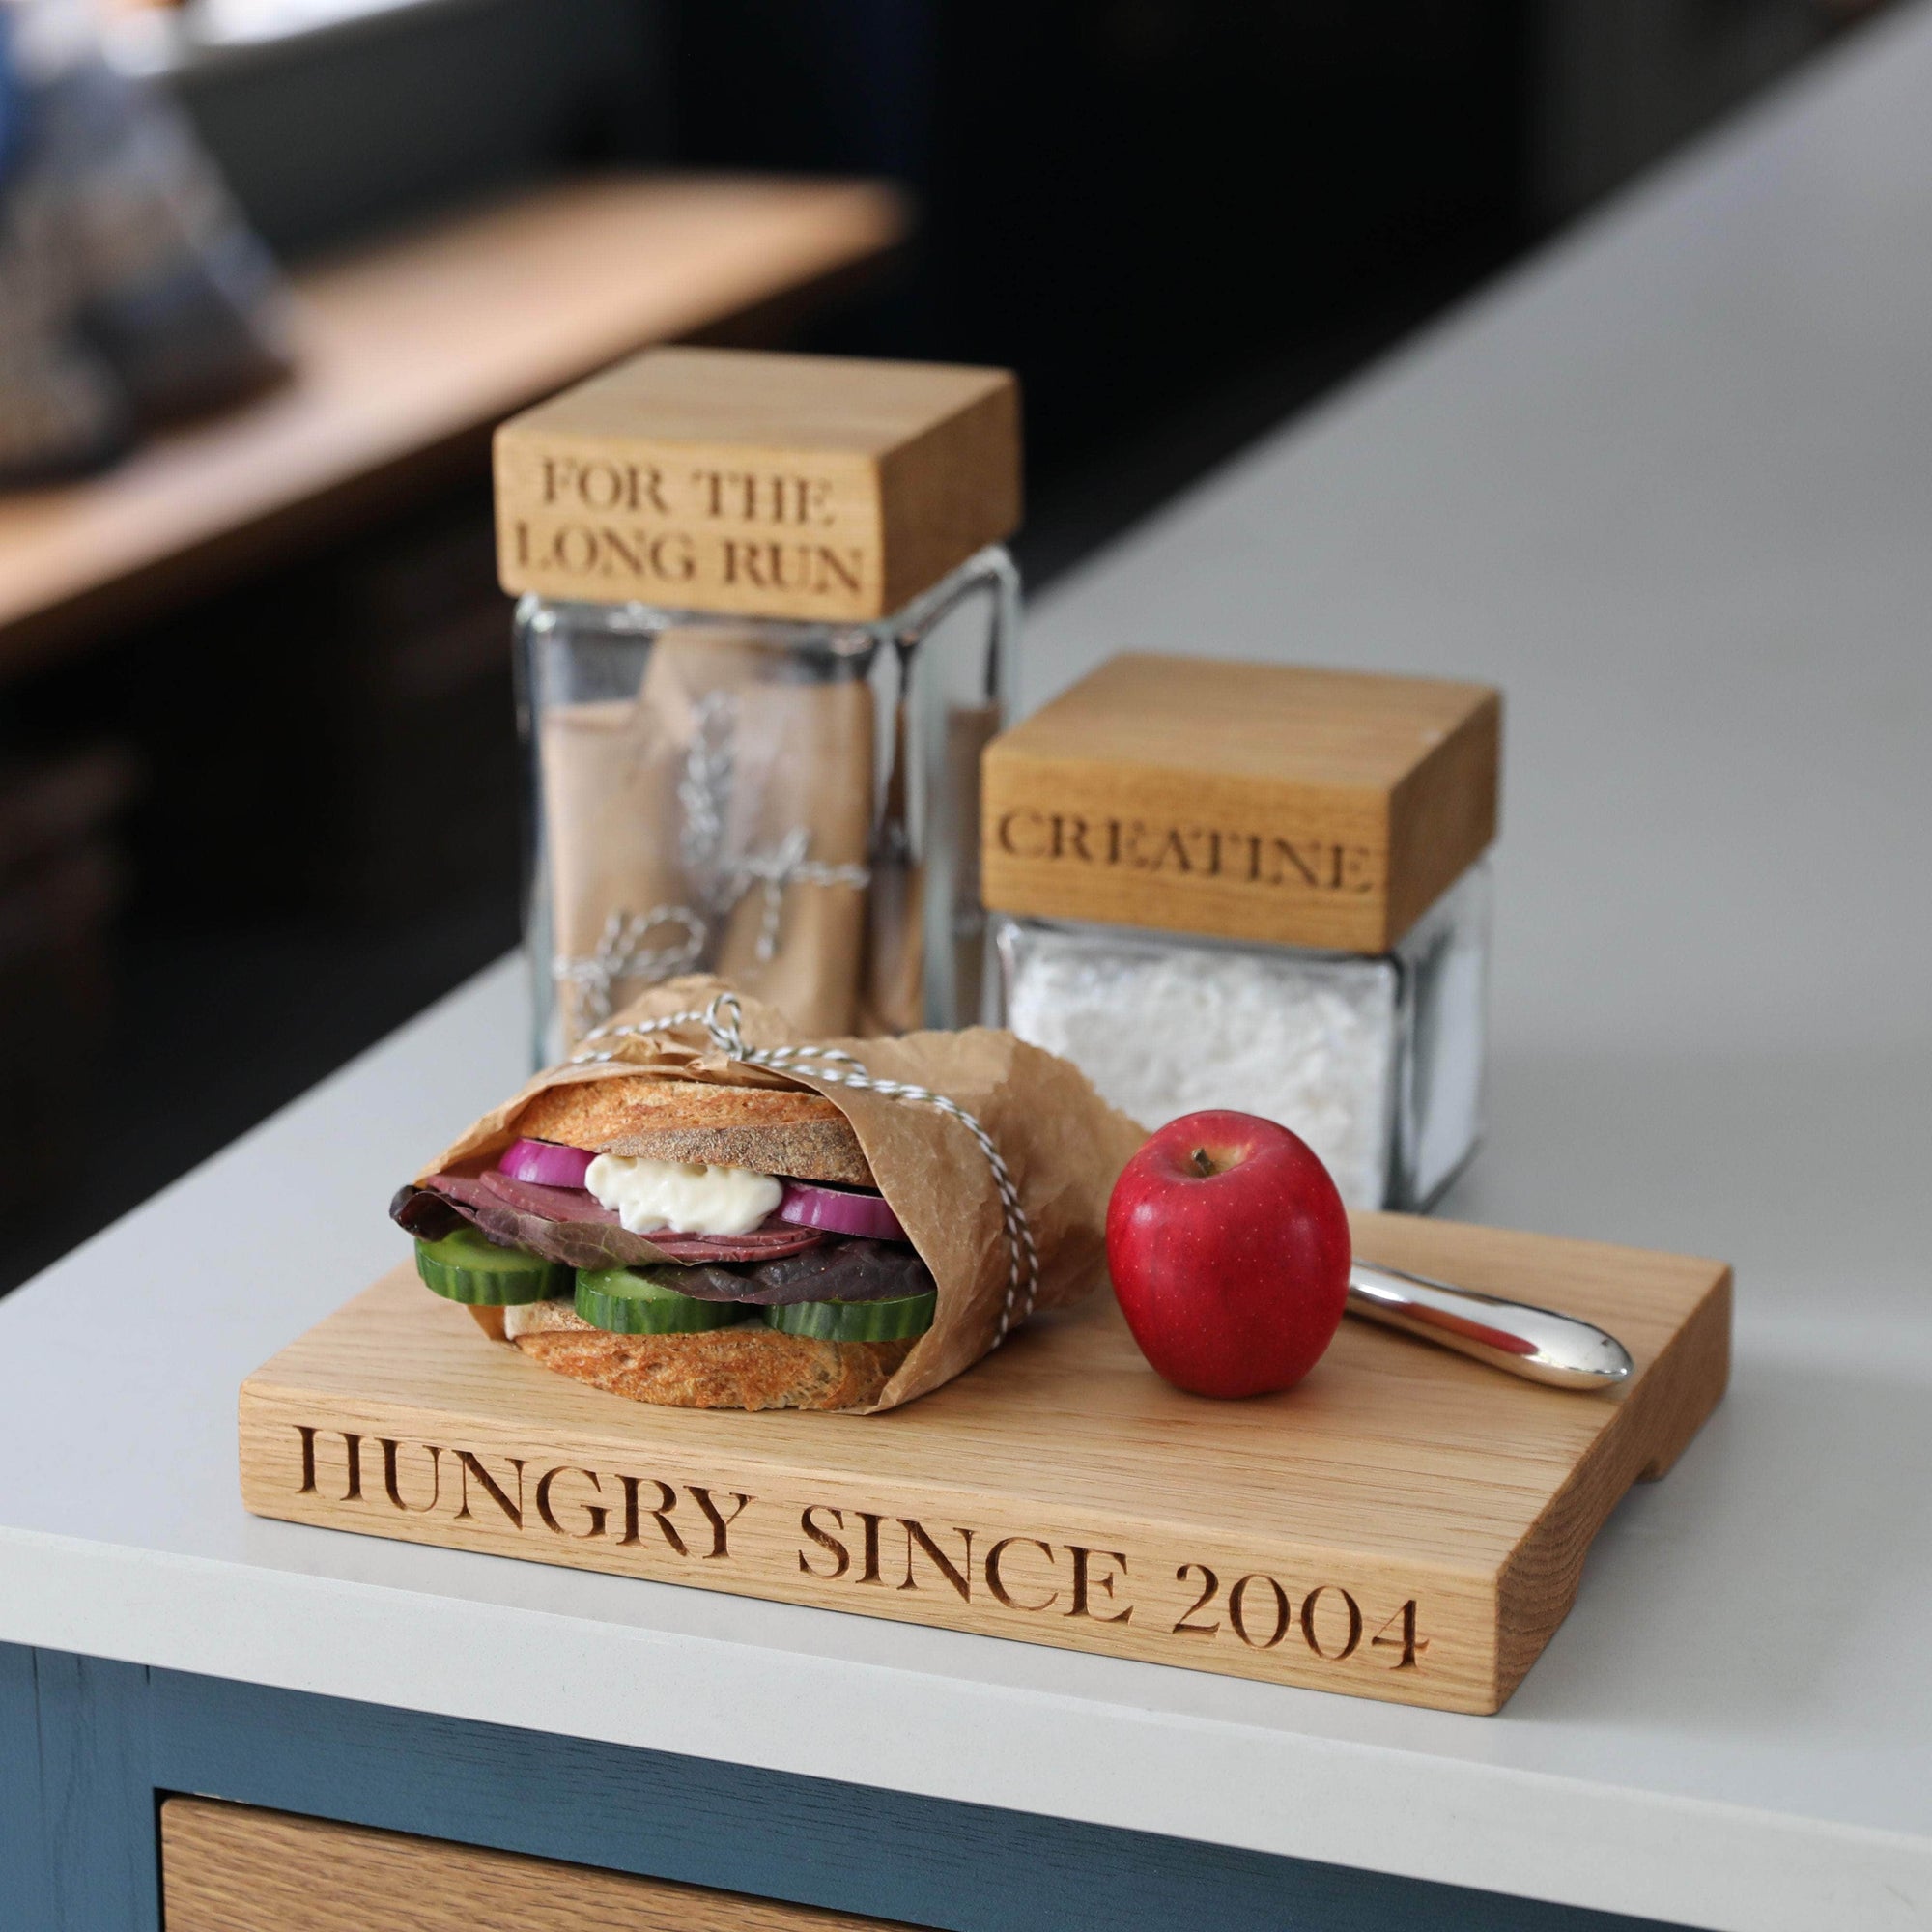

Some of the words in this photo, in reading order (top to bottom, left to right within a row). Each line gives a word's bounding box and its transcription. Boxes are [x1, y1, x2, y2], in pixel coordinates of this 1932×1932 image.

[542, 456, 668, 516] FOR
[693, 469, 835, 527] THE
[515, 520, 696, 582] LONG
[722, 539, 863, 597] RUN
[997, 807, 1374, 893] CREATINE
[292, 1424, 759, 1560] HUNGRY
[798, 1504, 1134, 1626] SINCE
[1172, 1562, 1430, 1669] 2004
